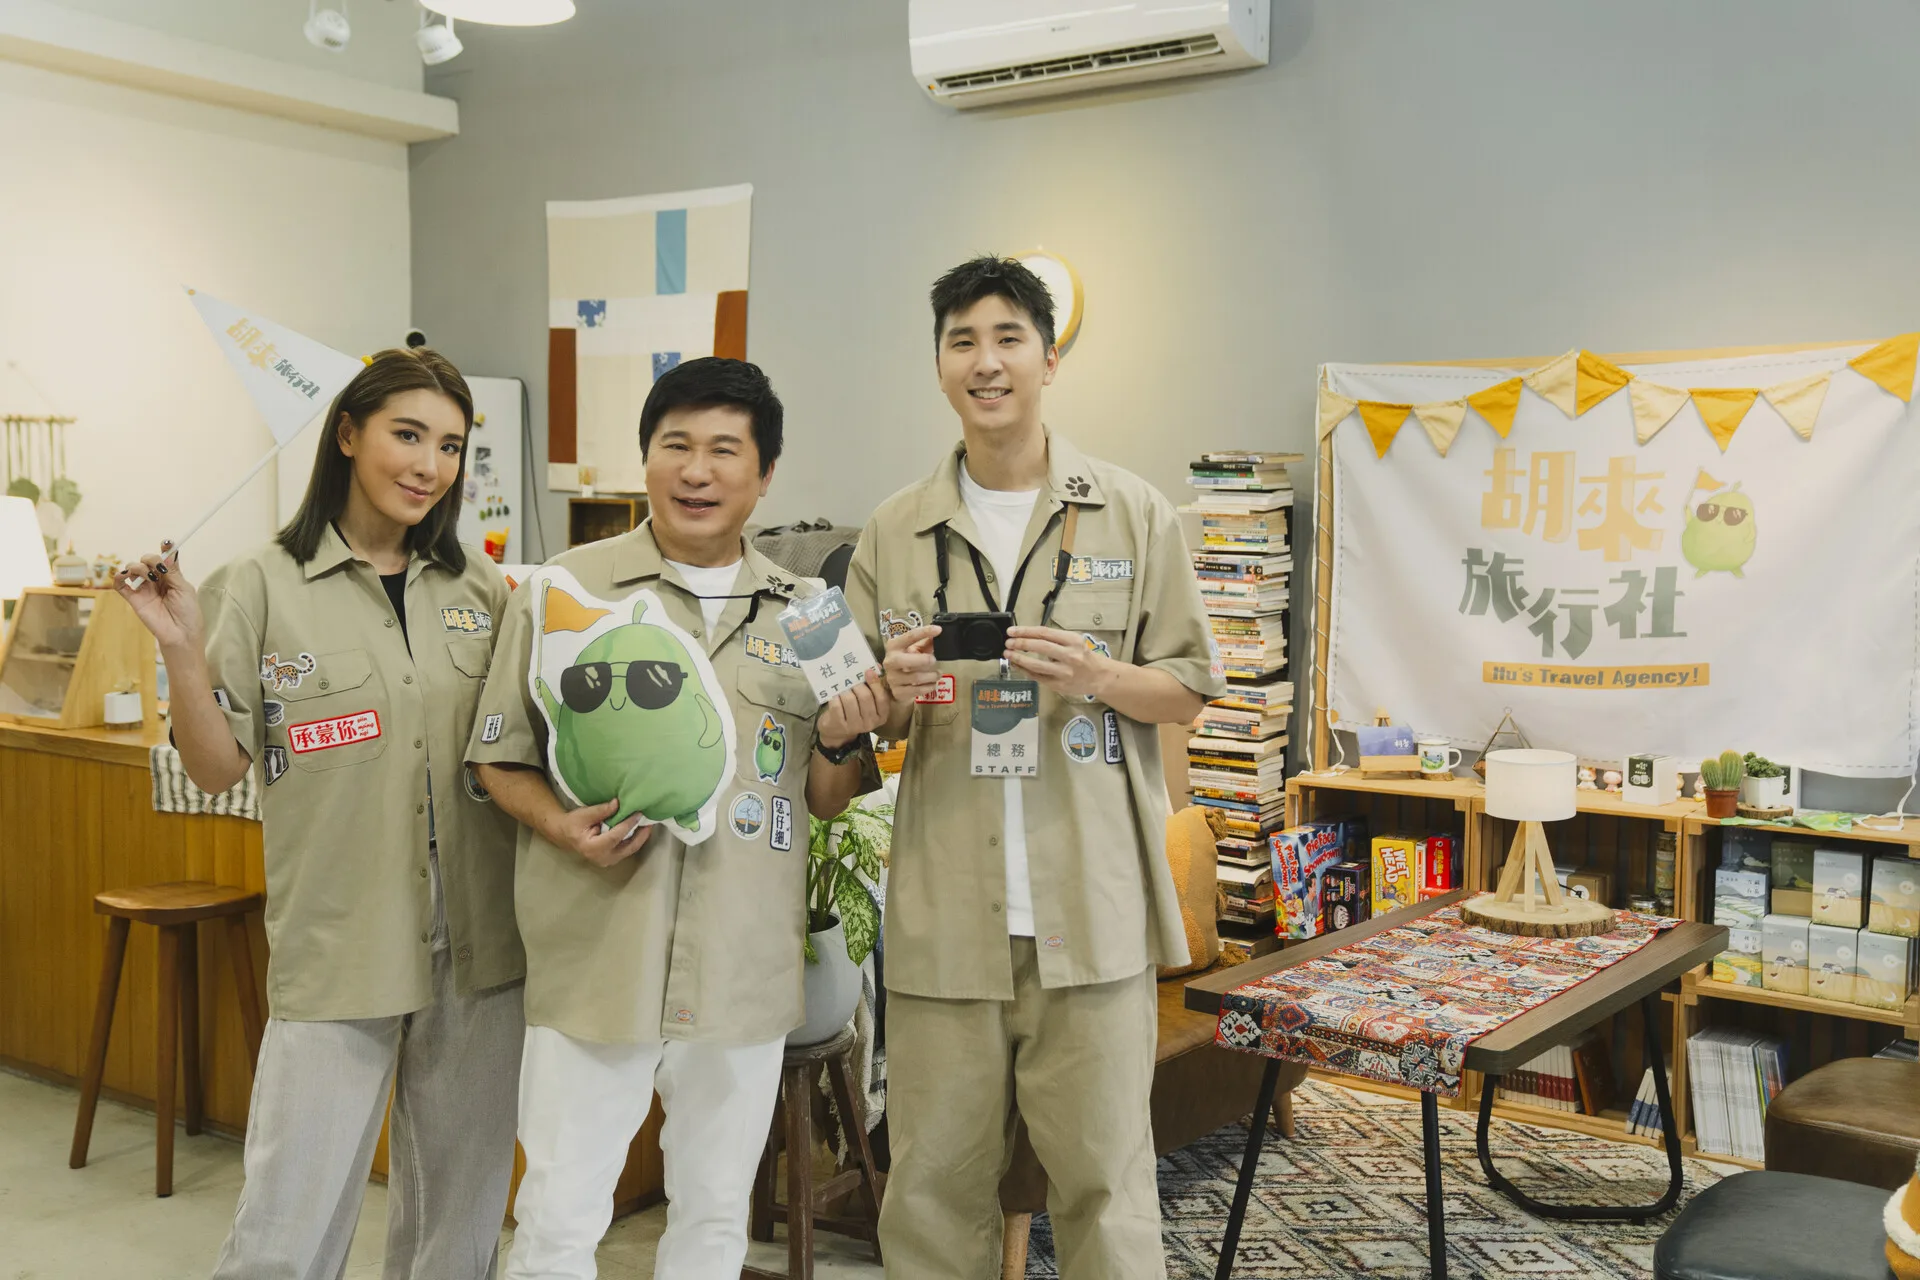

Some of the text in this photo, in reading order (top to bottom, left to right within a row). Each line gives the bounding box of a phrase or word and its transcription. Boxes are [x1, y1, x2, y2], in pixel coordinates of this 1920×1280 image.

[1481, 447, 1666, 563] 胡來
[1458, 547, 1688, 660] 旅行社
[443, 609, 492, 631] 胡來旅
[746, 636, 800, 666] 胡來旅
[819, 652, 858, 679] 社長
[1493, 666, 1699, 688] Hu's Travel Agency!
[294, 720, 358, 748] 承蒙你
[987, 743, 1025, 758] 總務
[975, 765, 1036, 774] STAFF
[1380, 847, 1399, 883] HEAD
[1393, 848, 1410, 879] WET
